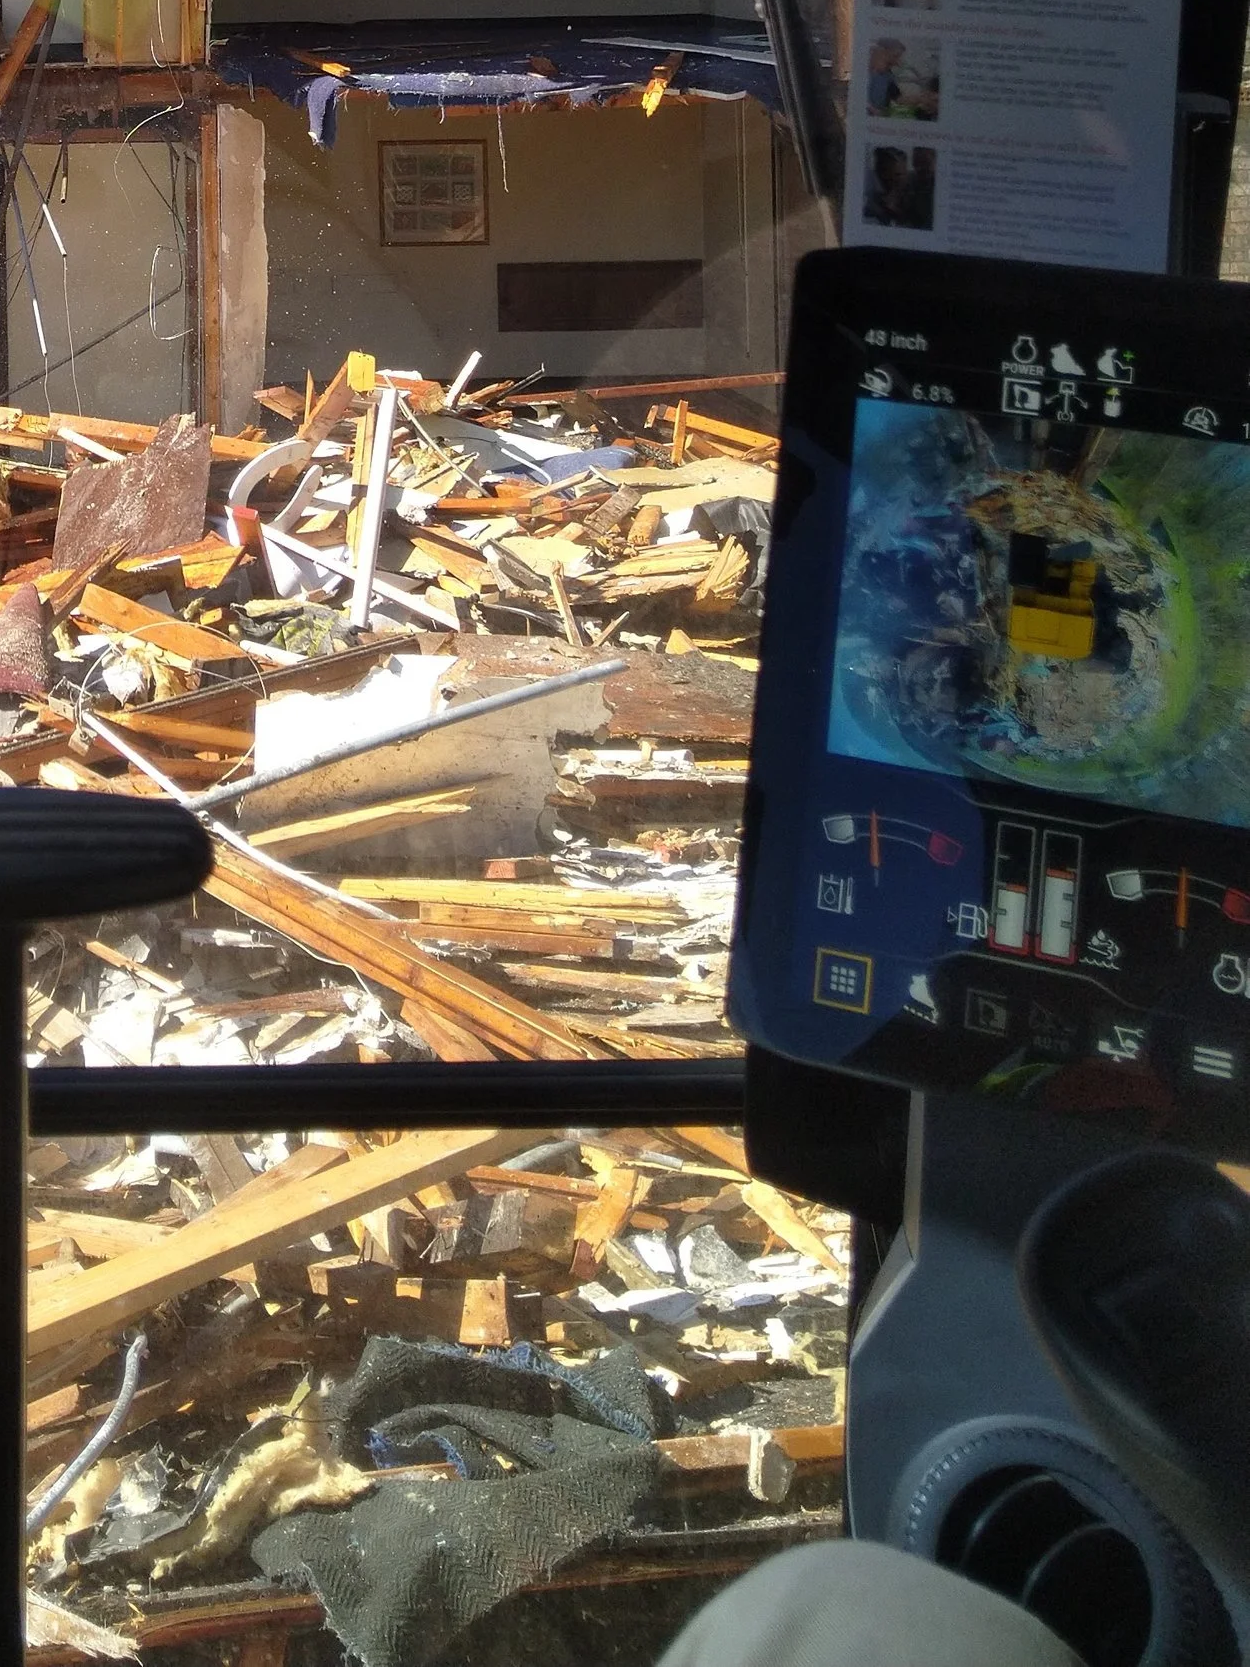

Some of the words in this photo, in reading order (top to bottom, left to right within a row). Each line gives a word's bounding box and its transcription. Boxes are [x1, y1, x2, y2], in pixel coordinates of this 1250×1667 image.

[864, 328, 888, 347] 48
[890, 330, 929, 352] inch
[1000, 361, 1046, 377] POWER
[911, 382, 955, 405] 6.8%
